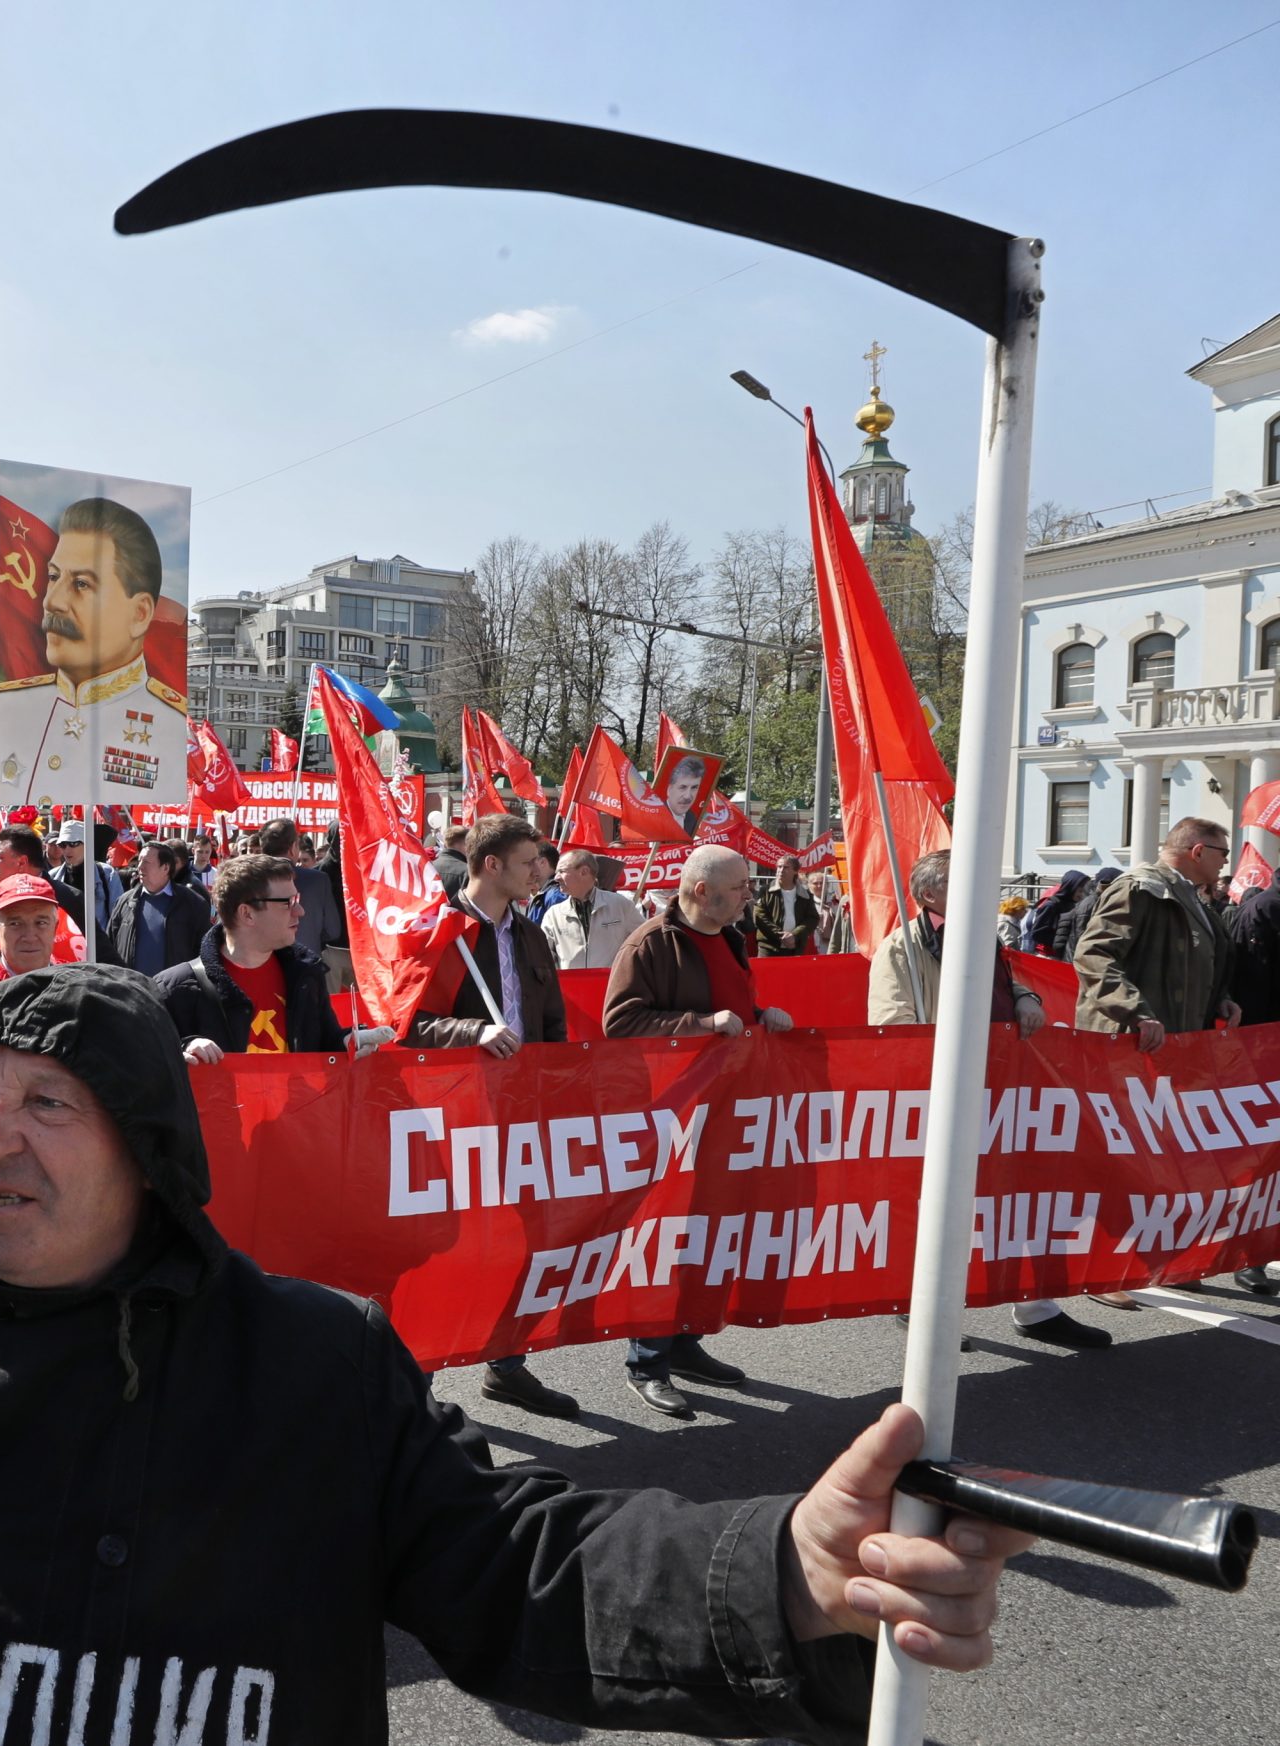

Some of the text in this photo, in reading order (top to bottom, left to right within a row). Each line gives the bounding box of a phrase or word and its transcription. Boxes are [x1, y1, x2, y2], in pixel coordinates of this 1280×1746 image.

[1040, 728, 1052, 737] 42
[143, 811, 190, 826] КПРФ
[388, 1103, 710, 1217] СПАСЕМ
[728, 1087, 1080, 1171] ЭКОЛОИЮ
[1125, 1076, 1280, 1155] МОС
[514, 1200, 890, 1318] СОХРАНИМ
[968, 1191, 1101, 1264] АШУ
